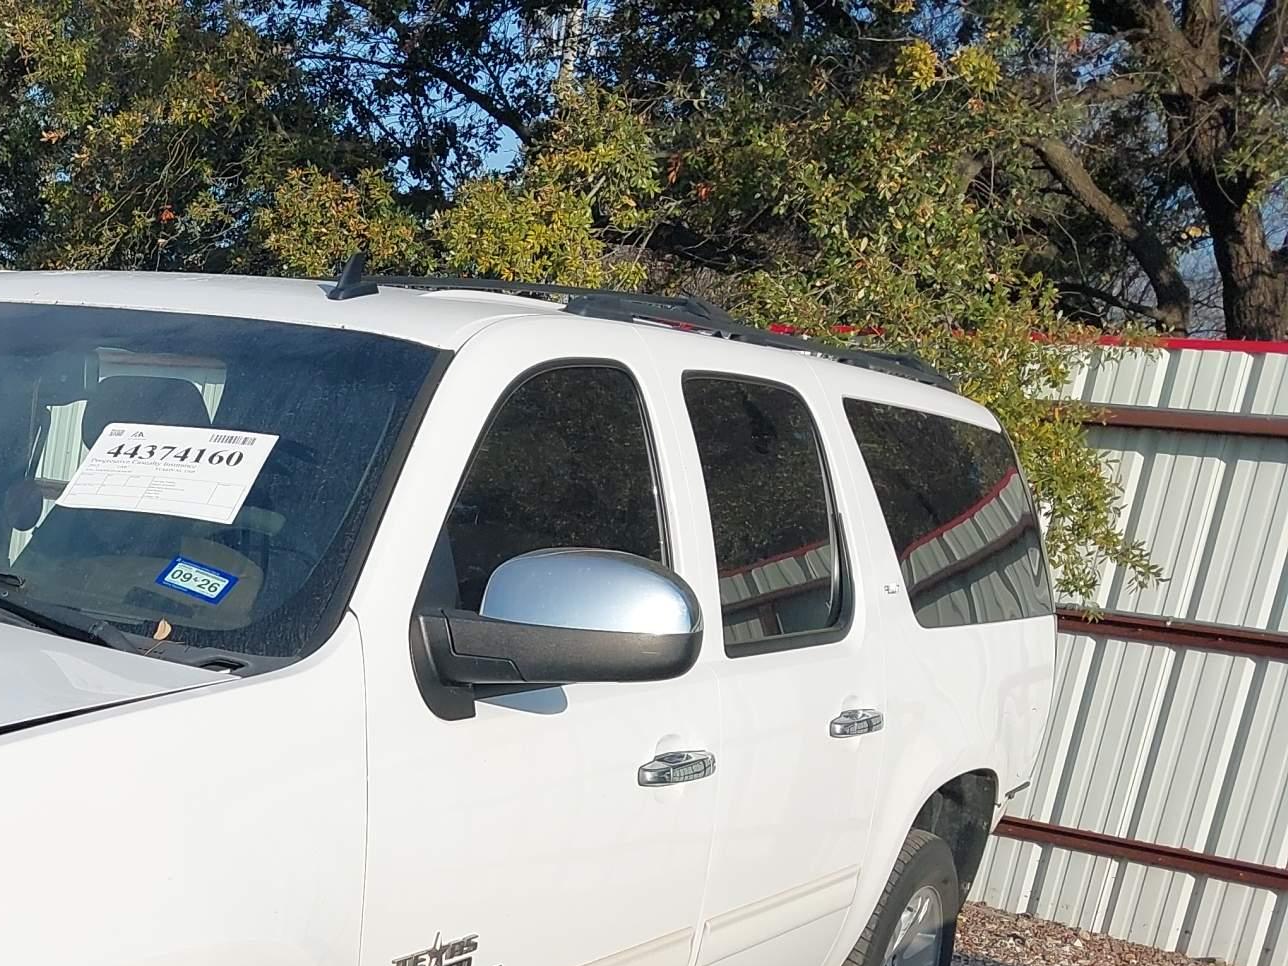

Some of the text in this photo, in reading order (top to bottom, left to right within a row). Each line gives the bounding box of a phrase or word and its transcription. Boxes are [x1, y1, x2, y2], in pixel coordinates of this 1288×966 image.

[106, 443, 244, 467] 44374160
[170, 569, 193, 583] 09
[196, 578, 221, 593] 26
